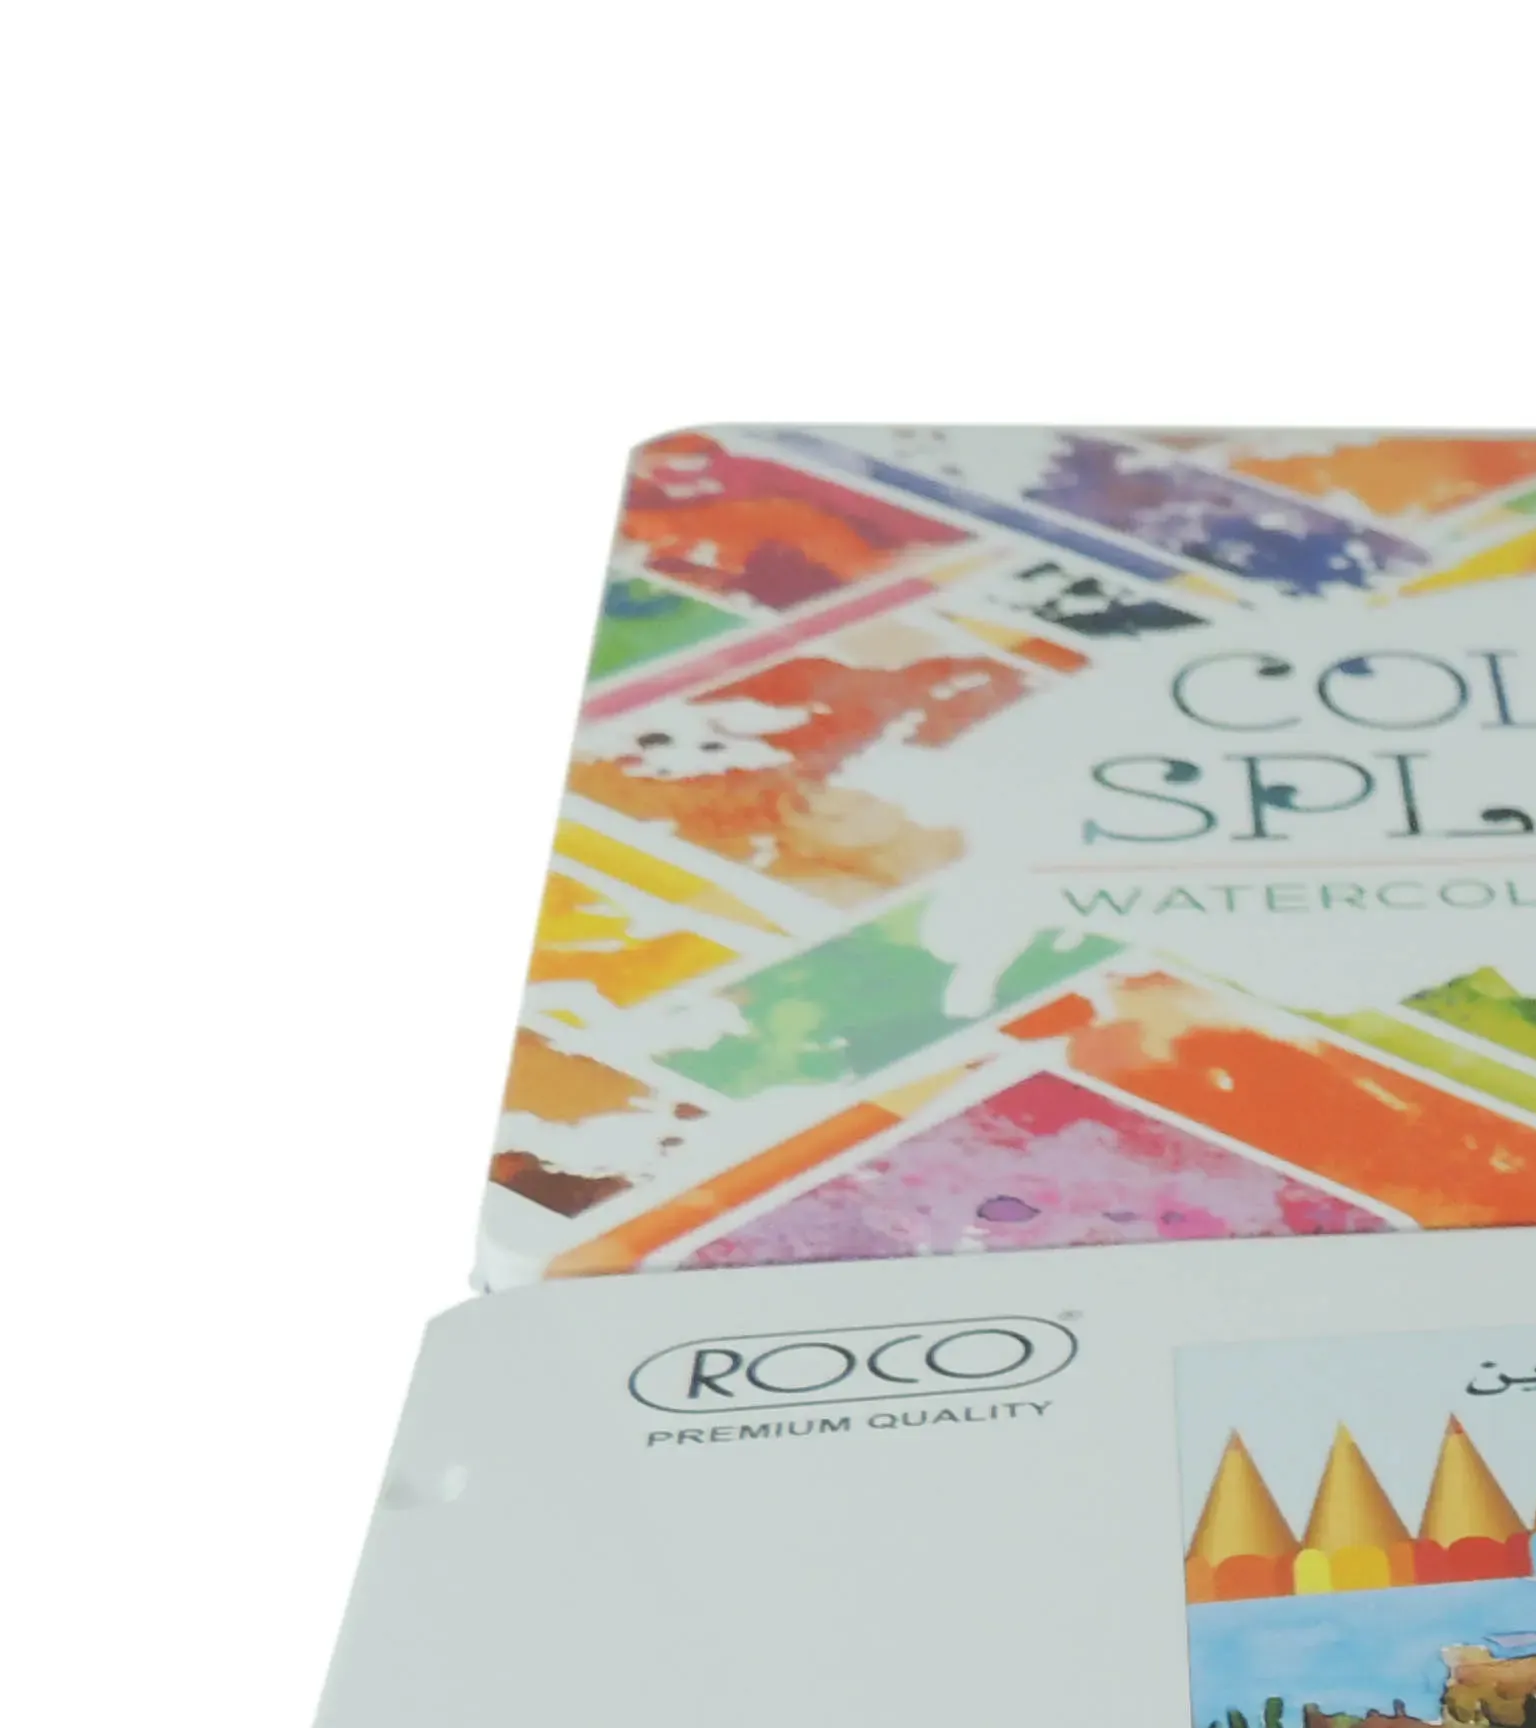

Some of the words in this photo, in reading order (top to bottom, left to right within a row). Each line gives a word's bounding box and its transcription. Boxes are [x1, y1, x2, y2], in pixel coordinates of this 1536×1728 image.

[686, 1327, 1035, 1400] ROCO
[646, 1415, 852, 1447] PREMIUM
[867, 1400, 1054, 1431] QUALITY
